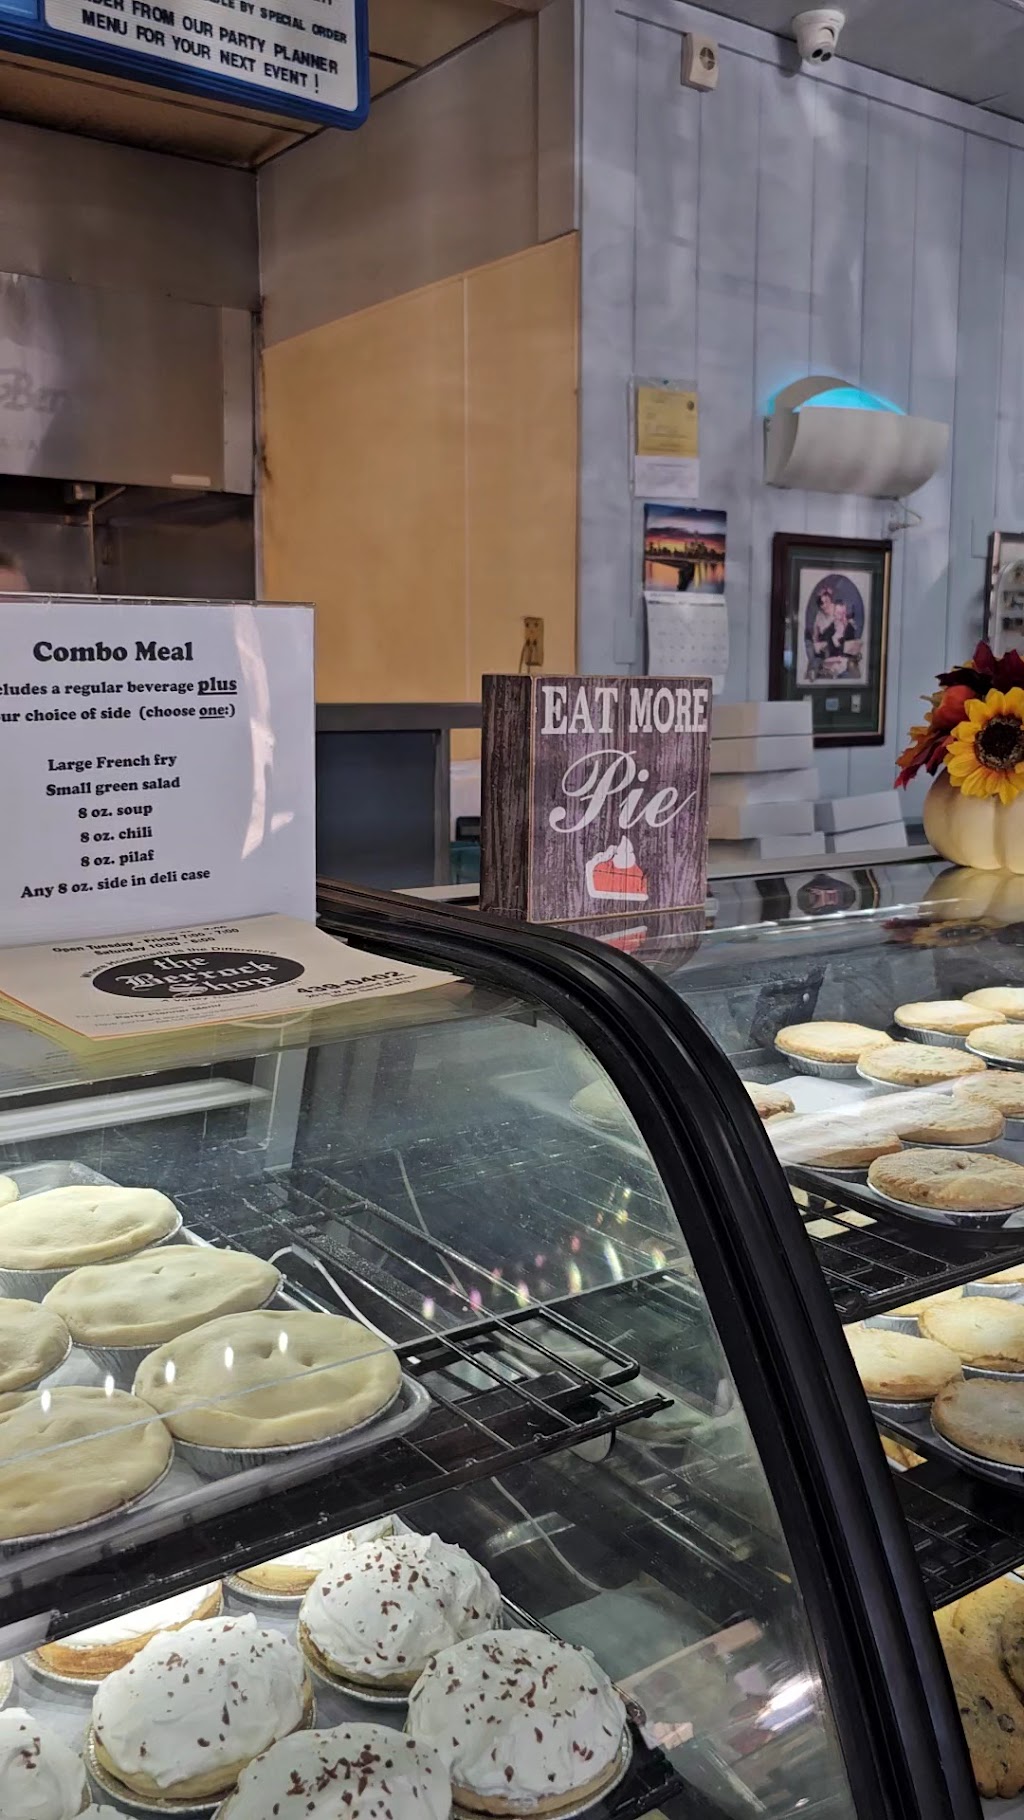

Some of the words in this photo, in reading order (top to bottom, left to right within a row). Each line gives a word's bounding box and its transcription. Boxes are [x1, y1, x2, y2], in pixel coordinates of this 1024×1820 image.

[240, 1, 254, 15] BY
[260, 8, 306, 30] SPECIAL
[312, 23, 347, 44] ORDER
[132, 0, 175, 26] FROM
[182, 16, 213, 38] OUR
[219, 26, 266, 53] PARTY
[274, 43, 338, 74] PLANNER
[82, 9, 127, 35] MENU
[136, 25, 165, 47] FOR
[172, 35, 211, 59] YOUR
[220, 50, 256, 72] NEXT
[264, 63, 308, 87] EVENT
[33, 641, 128, 662] Combo
[135, 641, 194, 661] Meal
[51, 685, 60, 694] a
[64, 681, 123, 697] regular
[127, 680, 194, 695] beverage
[197, 676, 238, 696] plus
[0, 712, 20, 722] ur
[25, 708, 77, 721] choice
[81, 707, 97, 720] of
[100, 706, 131, 719] side
[139, 704, 196, 721] (choose
[199, 703, 236, 719] one:)
[541, 685, 618, 735] EAT
[628, 687, 708, 733] MORE
[48, 759, 92, 772] Large
[96, 755, 150, 769] French
[154, 754, 178, 767] fry
[46, 782, 91, 796] Small
[95, 781, 139, 796] green
[142, 777, 180, 790] salad
[549, 749, 697, 833] Pie
[78, 807, 87, 819] 8
[91, 806, 113, 818] oz.
[117, 804, 153, 816] soup
[80, 831, 90, 843] 8
[93, 830, 115, 842] oz.
[118, 826, 153, 839] chili
[80, 855, 90, 867] 8
[94, 854, 115, 866] oz.
[119, 850, 155, 865] pilaf
[20, 885, 54, 899] Any
[58, 883, 68, 894] 8
[71, 881, 93, 893] oz.
[97, 877, 128, 890] side
[131, 875, 146, 887] in
[150, 871, 178, 884] deli
[181, 868, 211, 880] case
[52, 945, 84, 953] Open
[86, 941, 134, 950] Tuesday
[144, 935, 178, 943] Friday
[94, 945, 146, 955] Saturday
[150, 941, 181, 949] 10:00
[211, 946, 277, 955] Difference
[153, 957, 209, 970] the
[115, 961, 278, 991] Berrock
[297, 971, 404, 994] 439-0402
[168, 975, 276, 999] Shop
[148, 1008, 189, 1016] Planner
